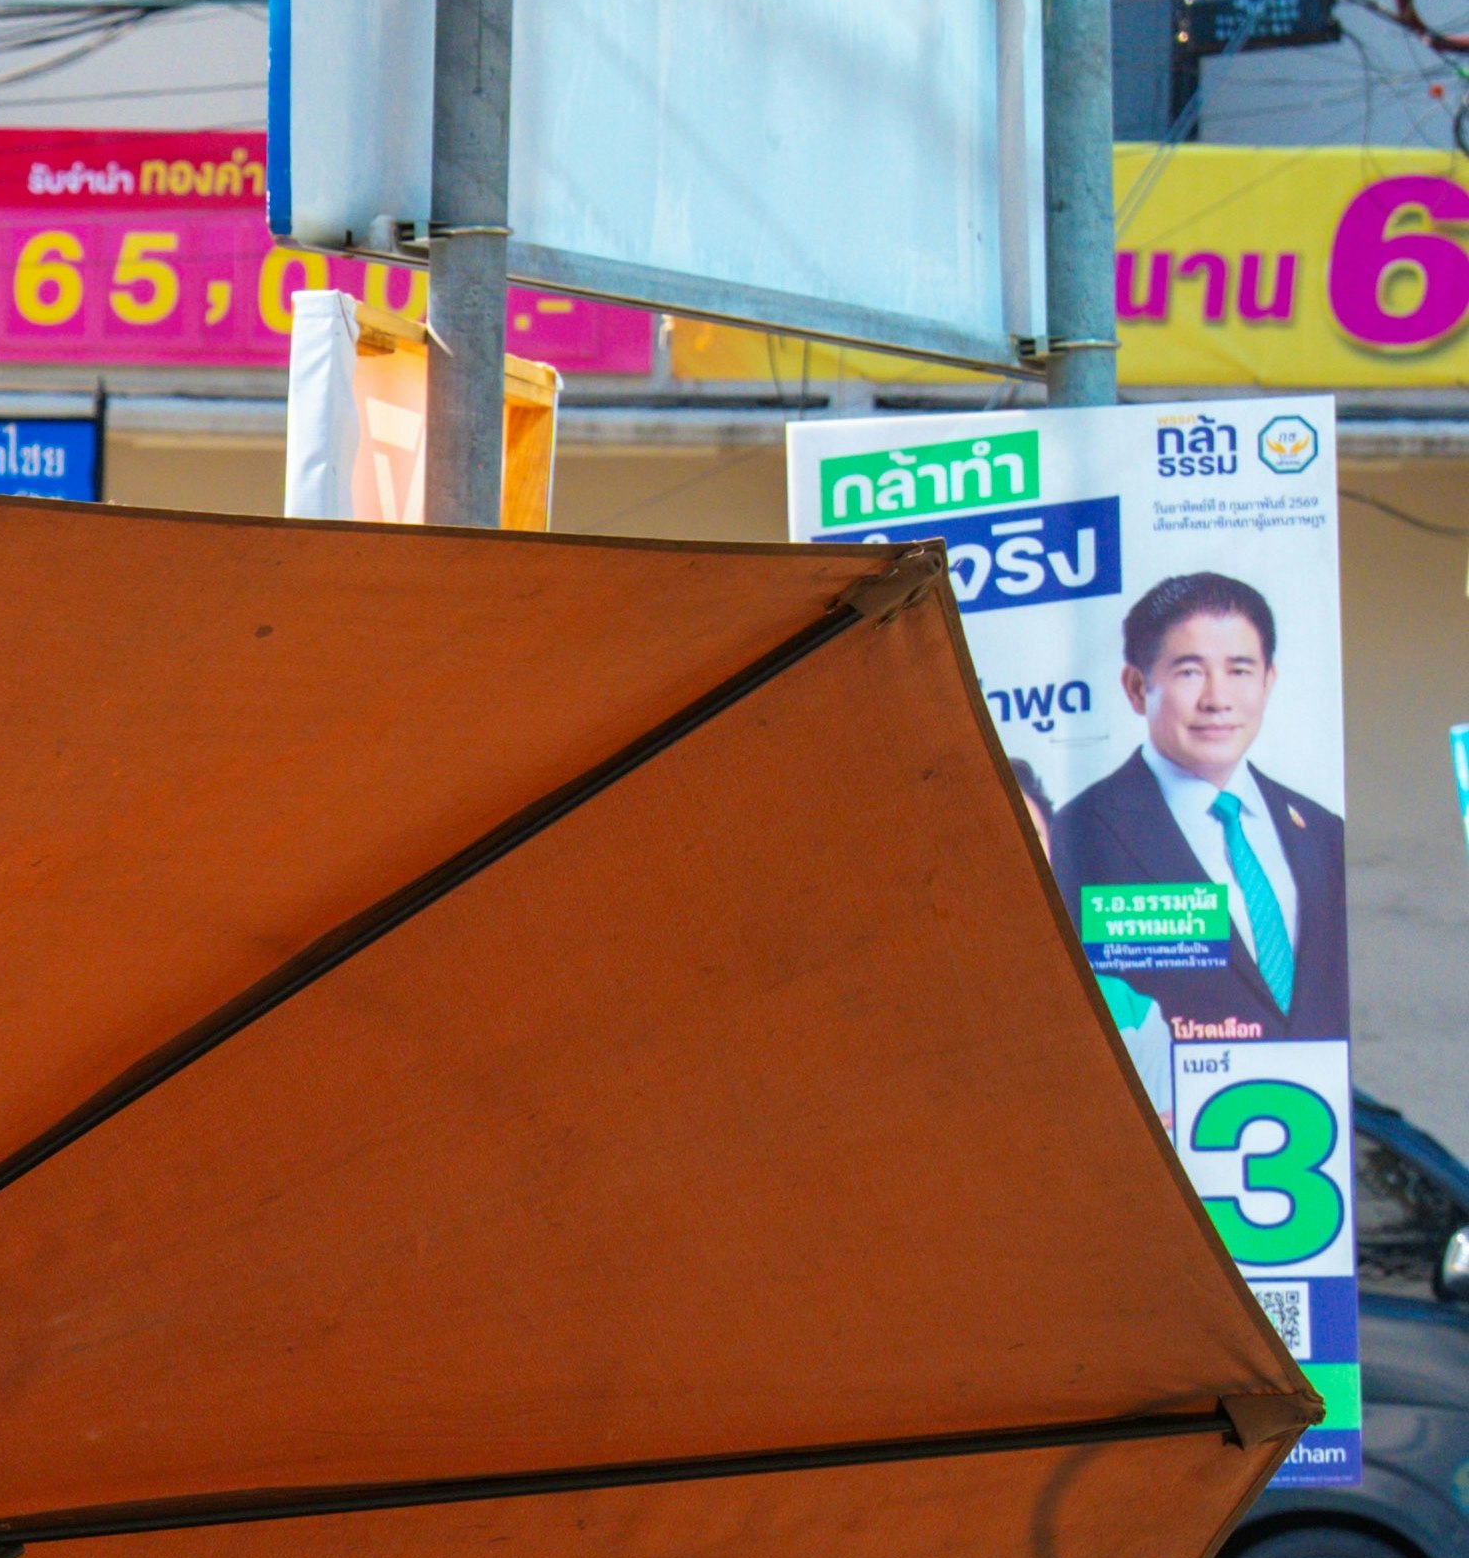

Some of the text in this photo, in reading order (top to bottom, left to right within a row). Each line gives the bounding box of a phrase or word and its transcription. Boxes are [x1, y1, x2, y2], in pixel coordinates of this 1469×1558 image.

[27, 147, 266, 196] รับจำนำ ทองคำ
[1326, 173, 1469, 347] 6
[1156, 414, 1237, 455] กล้า
[831, 440, 1026, 519] กล้าทำ
[1157, 454, 1237, 478] ธรรม
[1288, 496, 1319, 509] 2569
[978, 677, 1091, 733] ่าพูด
[1090, 887, 1219, 914] ร.อ.ธรรมนัส
[1105, 909, 1207, 938] พรหมเผ่า
[1089, 956, 1153, 972] ายกรัฐมนตรี
[1170, 1016, 1263, 1041] โปรดเลือก
[1182, 1049, 1231, 1074] เบอร์
[1190, 1079, 1345, 1266] 3
